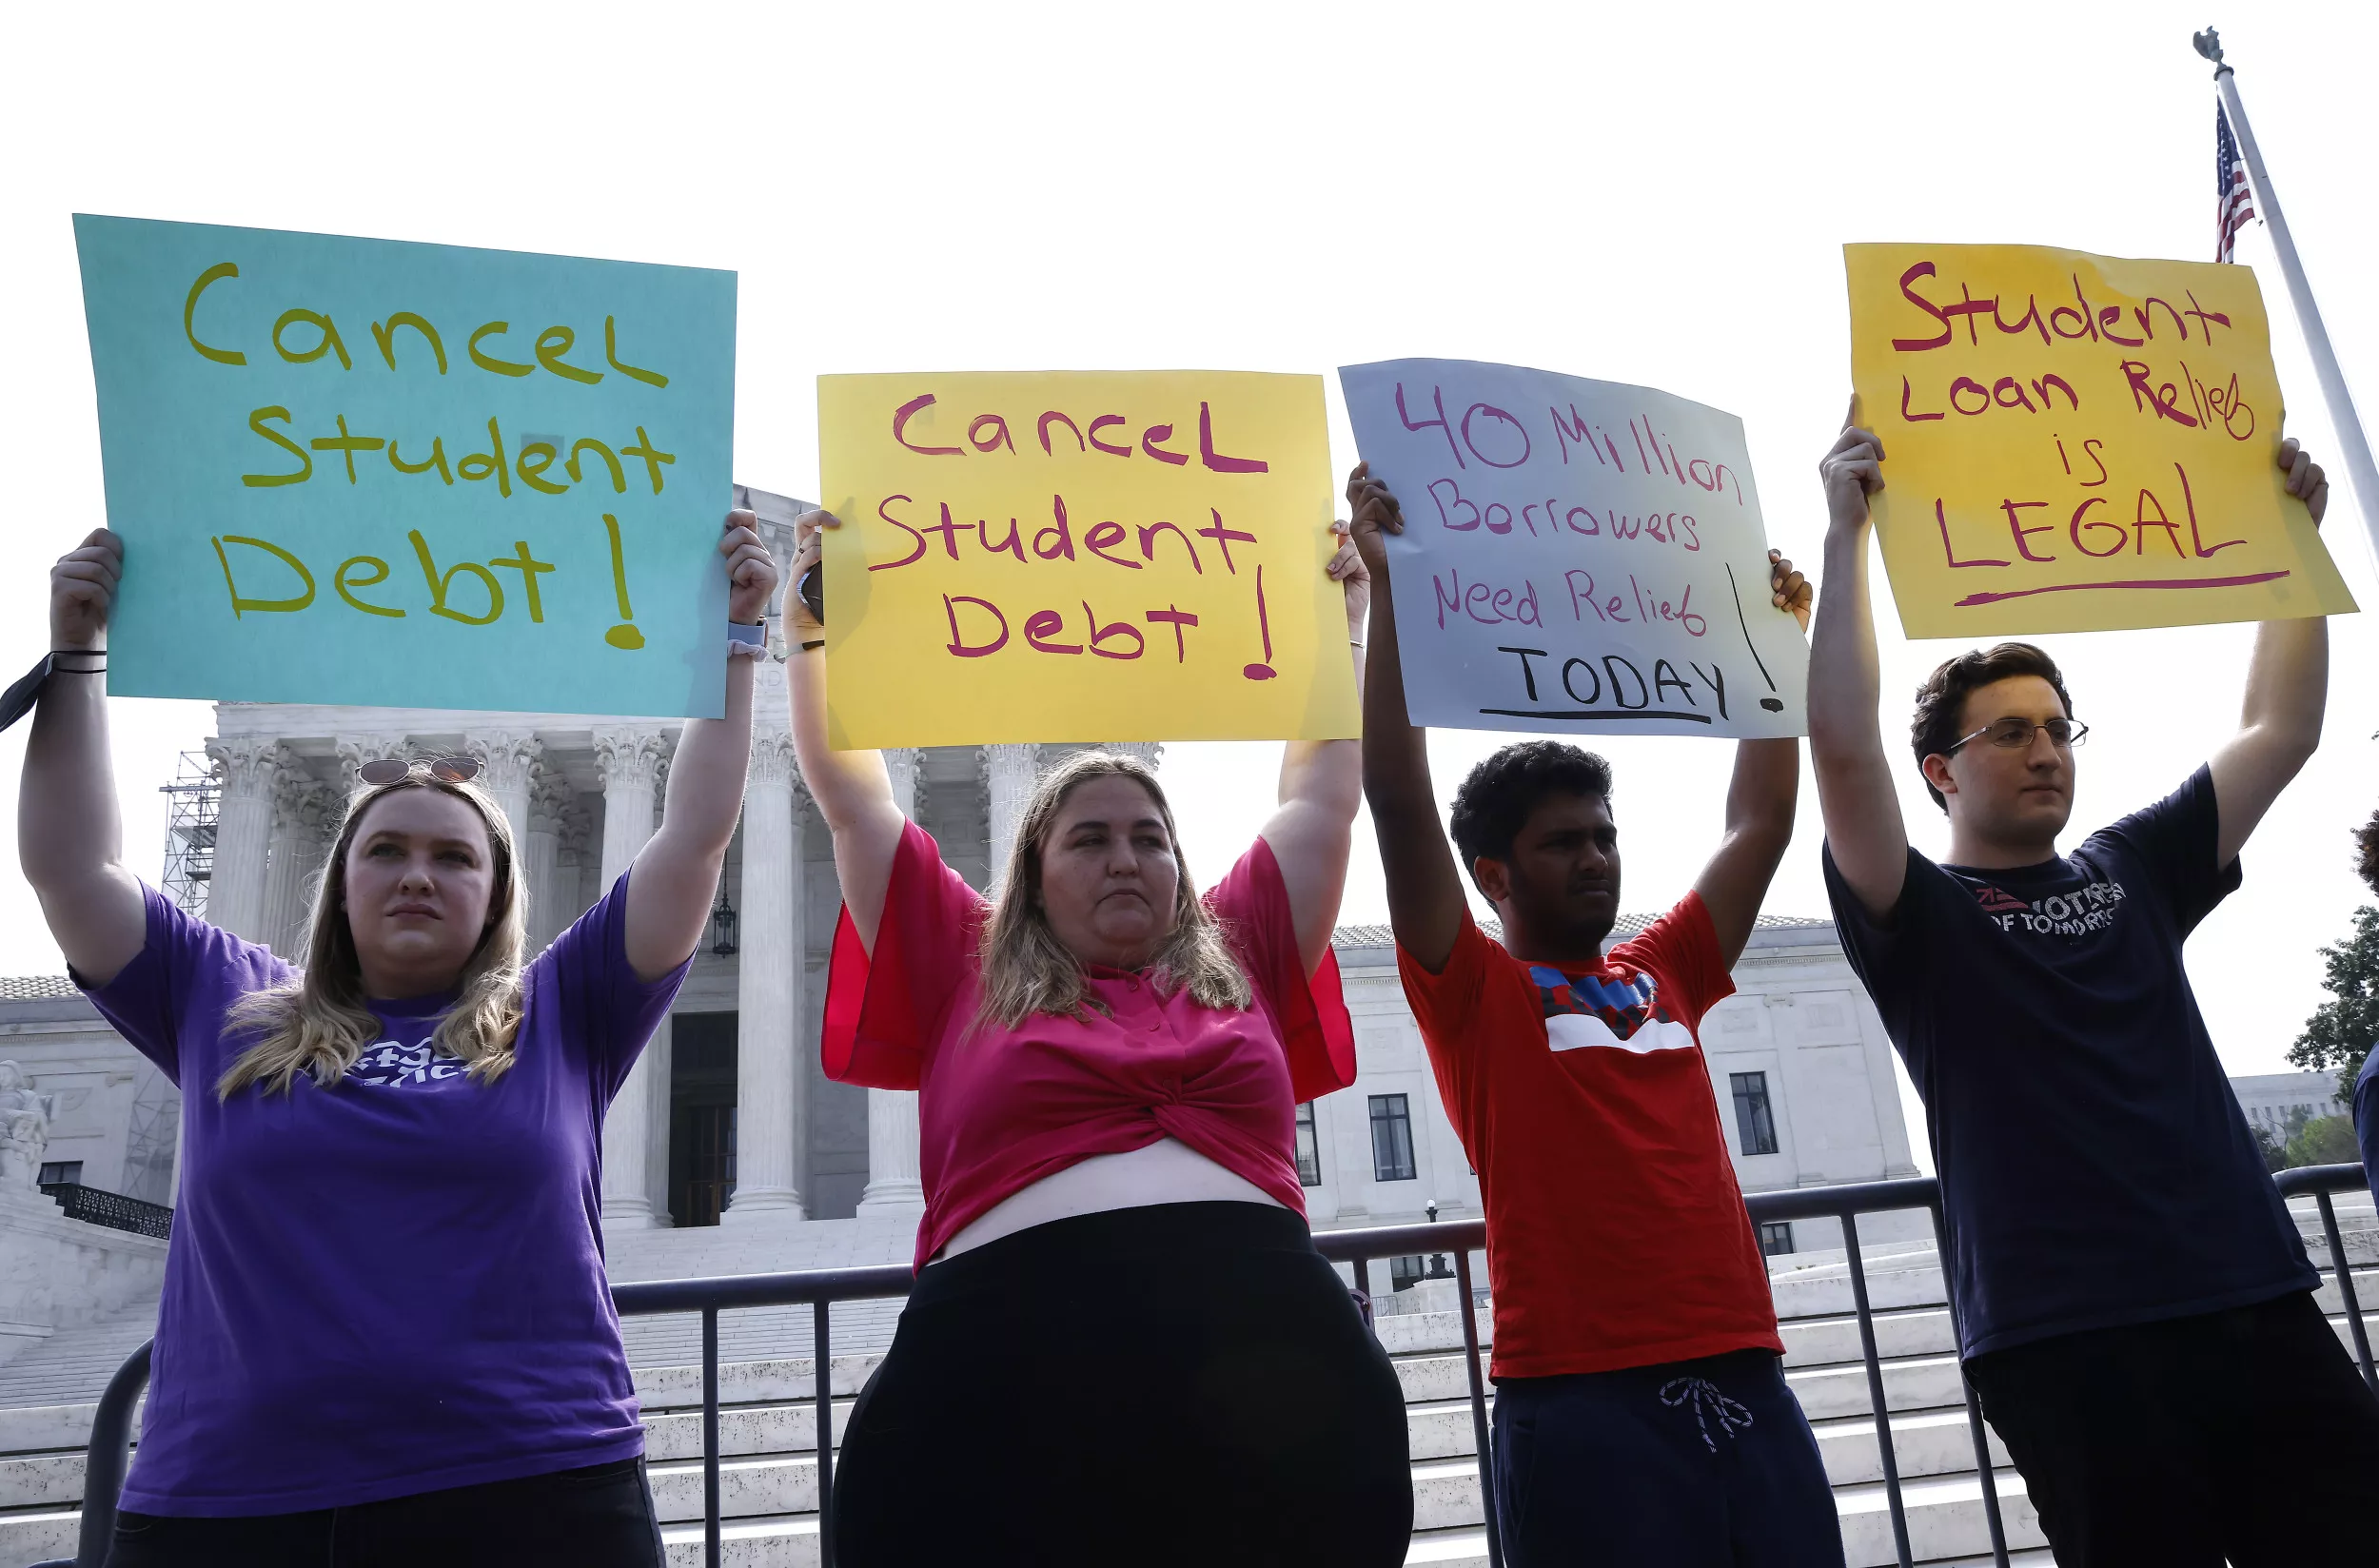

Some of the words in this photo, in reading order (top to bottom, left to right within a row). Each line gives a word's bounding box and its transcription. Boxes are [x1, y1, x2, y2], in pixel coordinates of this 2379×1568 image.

[1891, 261, 2232, 352] Student
[1902, 374, 2078, 421] Loan
[240, 405, 677, 499] Student
[1395, 382, 1531, 470] 40
[1550, 403, 1743, 506] Million
[2053, 433, 2108, 487] is
[868, 494, 1257, 575] Student
[1427, 478, 1701, 552] Borrowers
[1935, 461, 2248, 569] LEGAL
[1433, 568, 1543, 630] Need
